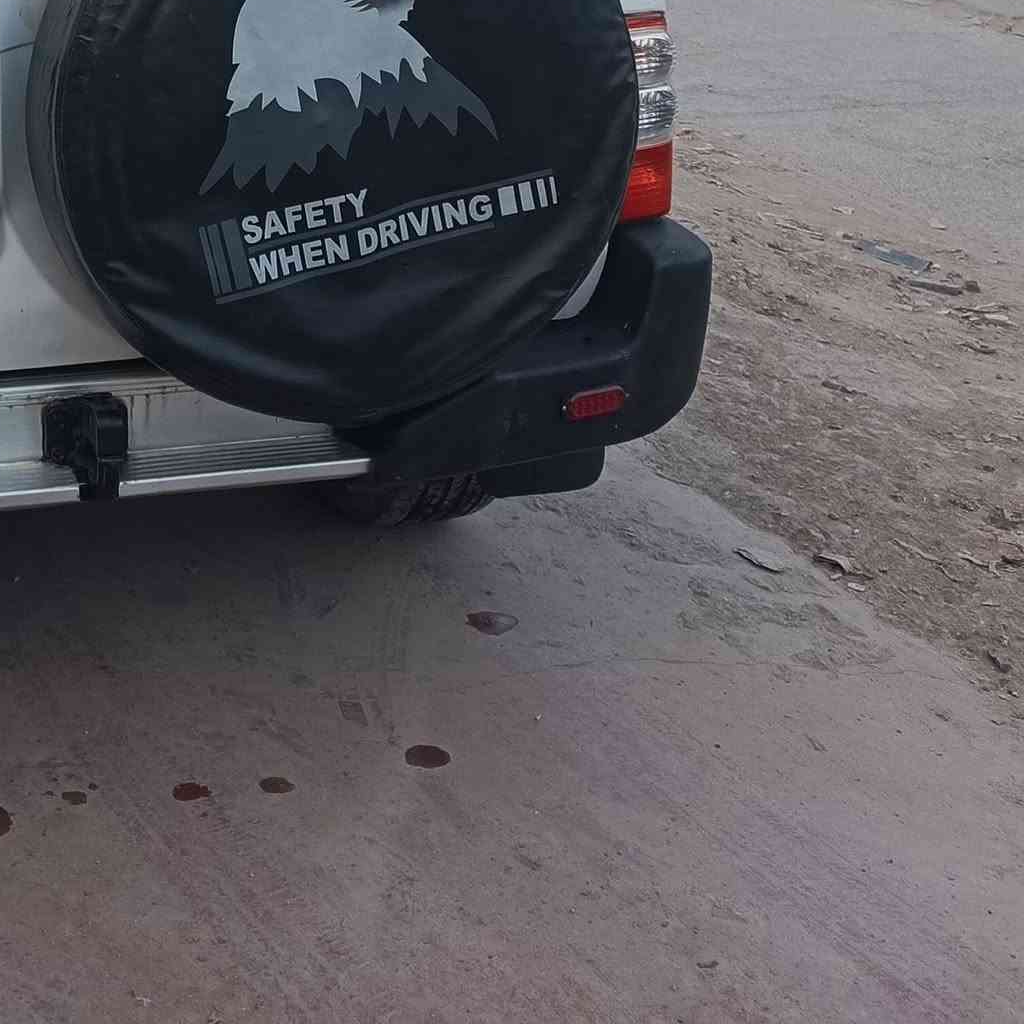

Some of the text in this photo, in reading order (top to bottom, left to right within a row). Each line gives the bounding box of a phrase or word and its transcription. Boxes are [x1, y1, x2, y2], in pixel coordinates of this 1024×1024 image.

[241, 188, 368, 245] SAFETY
[249, 193, 494, 286] WHEN DRIVING
